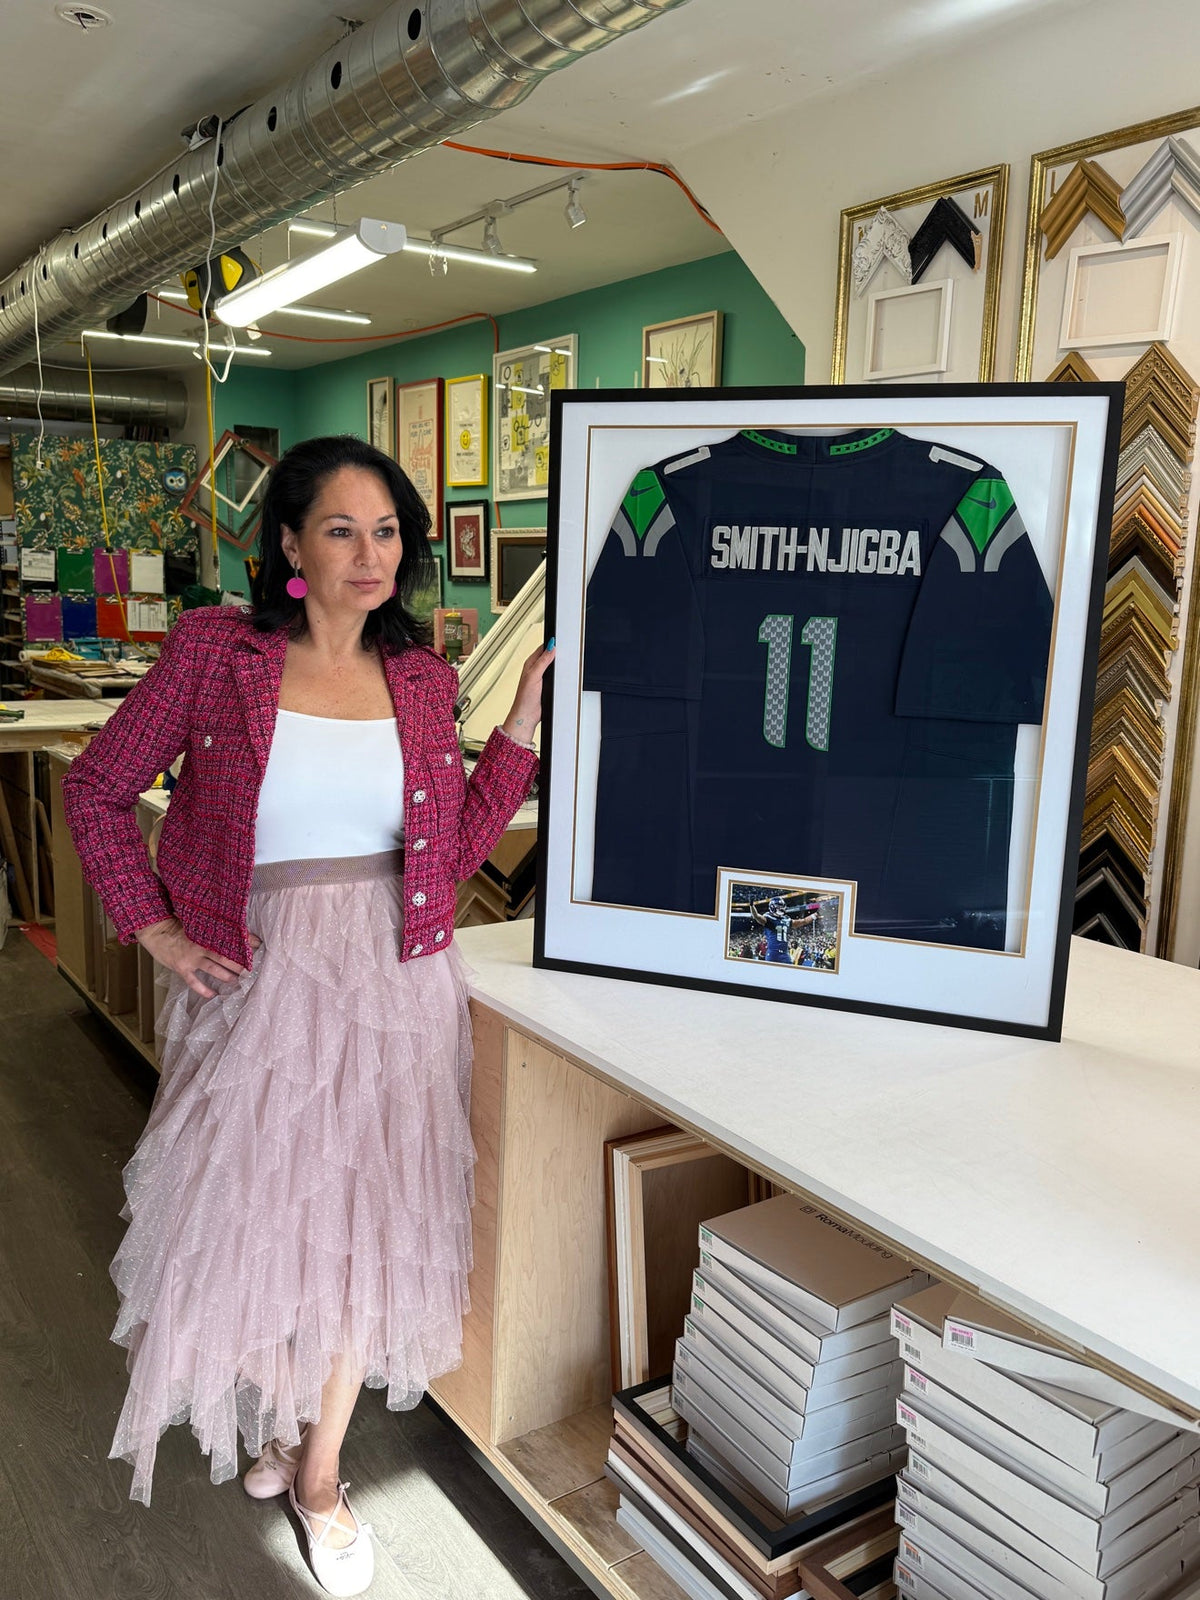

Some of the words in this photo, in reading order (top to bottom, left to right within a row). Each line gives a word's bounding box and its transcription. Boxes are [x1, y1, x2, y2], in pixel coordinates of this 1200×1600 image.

[974, 191, 988, 219] M
[711, 526, 921, 576] SMITH-NJIGBA
[758, 615, 838, 751] 11
